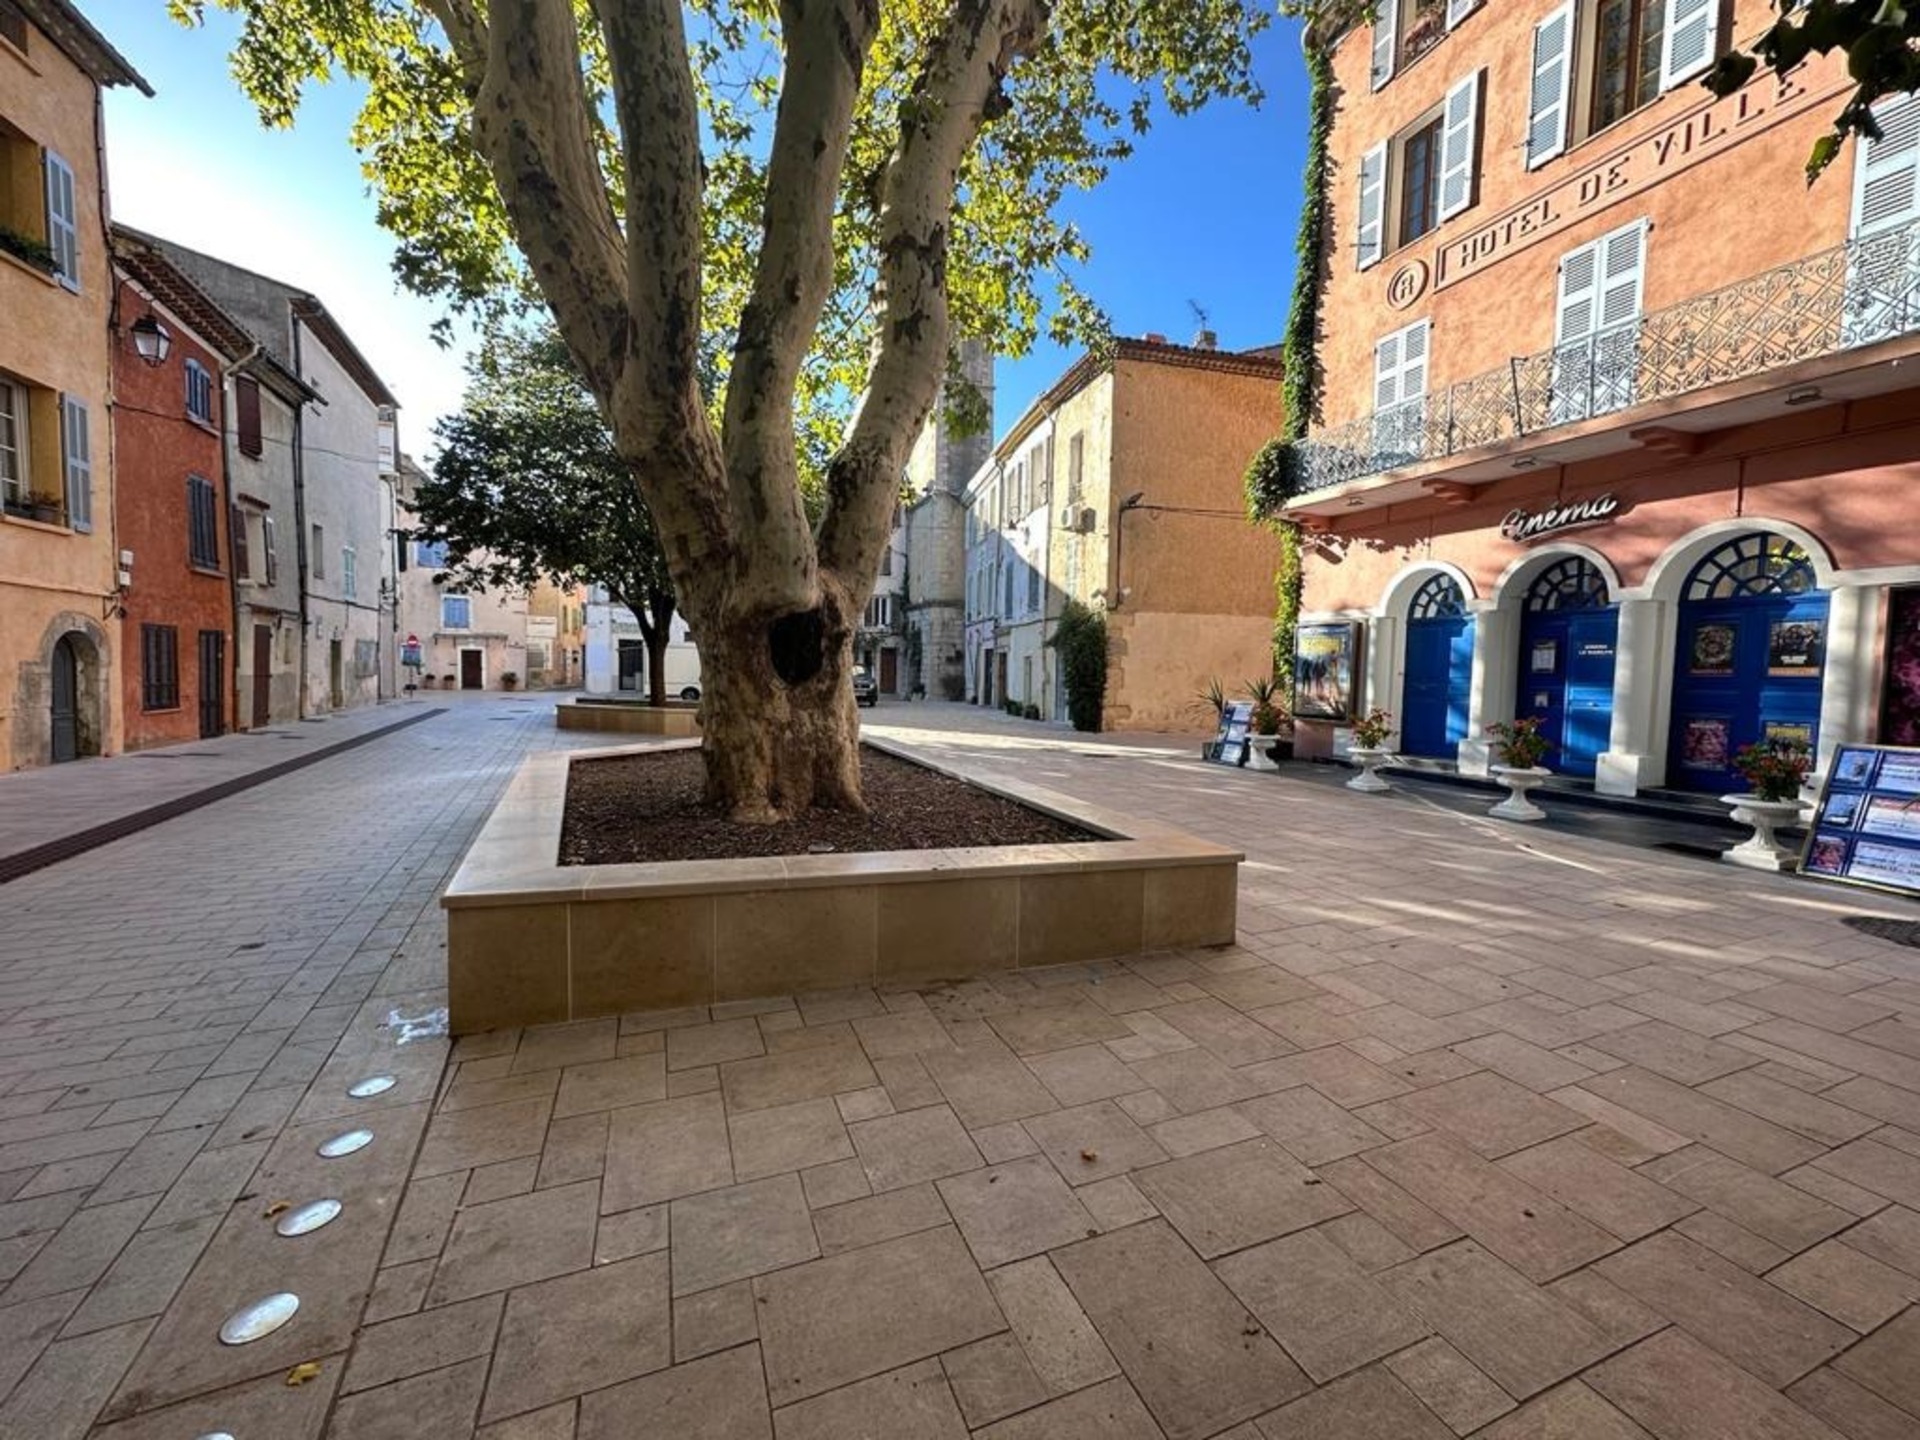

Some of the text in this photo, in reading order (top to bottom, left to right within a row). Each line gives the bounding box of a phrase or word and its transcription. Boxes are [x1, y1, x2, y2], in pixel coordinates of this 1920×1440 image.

[1460, 61, 1808, 268] HOTEL DE VILLE
